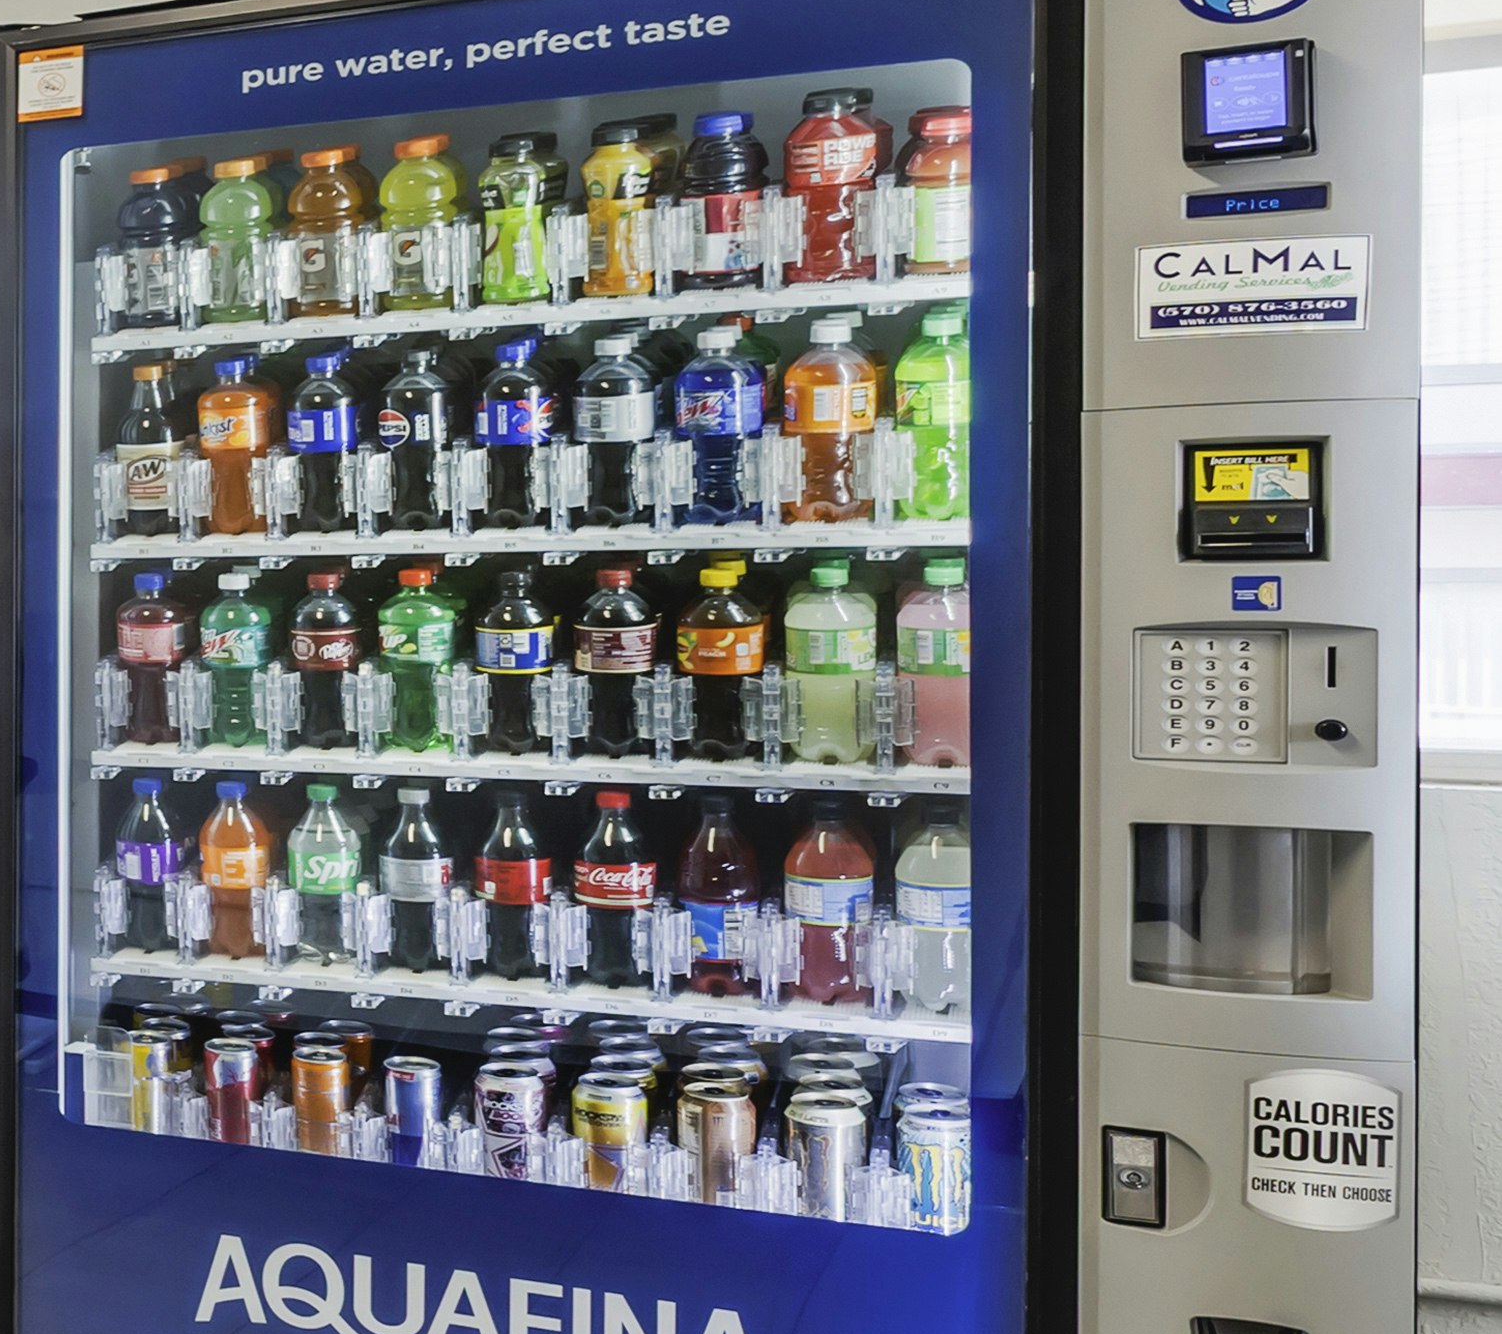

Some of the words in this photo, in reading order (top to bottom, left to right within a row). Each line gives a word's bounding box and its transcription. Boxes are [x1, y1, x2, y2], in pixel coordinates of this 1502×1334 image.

[241, 62, 324, 94] pure
[335, 49, 453, 79] water,
[466, 24, 612, 69] perfect
[624, 12, 731, 47] taste
[824, 133, 876, 152] POWE
[1224, 195, 1281, 212] Price
[393, 230, 422, 266] G
[300, 239, 326, 274] G
[1157, 277, 1229, 293] Vending
[1235, 275, 1312, 289] Services
[1157, 305, 1220, 317] (570)
[1228, 299, 1348, 313] 876-3560
[1179, 312, 1325, 326] WWW.CALMALVENDING.COM
[1209, 456, 1243, 466] INSERT
[1244, 456, 1262, 464] BILL
[1264, 455, 1289, 463] HERE
[1170, 640, 1184, 651] A
[1206, 640, 1214, 651] 1
[1239, 641, 1250, 652] 2
[1170, 660, 1183, 671] B
[1205, 660, 1216, 671] 3
[1239, 661, 1250, 671] 4
[1170, 679, 1183, 690] C
[1205, 680, 1216, 691] 5
[1239, 680, 1250, 691] 6
[1170, 699, 1183, 710] D
[1205, 700, 1216, 710] 7
[1239, 700, 1249, 711] 8
[1170, 718, 1182, 729] E
[1204, 719, 1215, 730] 9
[1238, 720, 1249, 731] 0
[1170, 738, 1182, 748] F
[304, 855, 361, 885] Spri
[1253, 1096, 1394, 1130] CALORIES
[1253, 1125, 1394, 1168] COUNT
[1251, 1176, 1296, 1195] CHECK
[1302, 1182, 1337, 1198] THEN
[1342, 1186, 1392, 1203] CHOOSE
